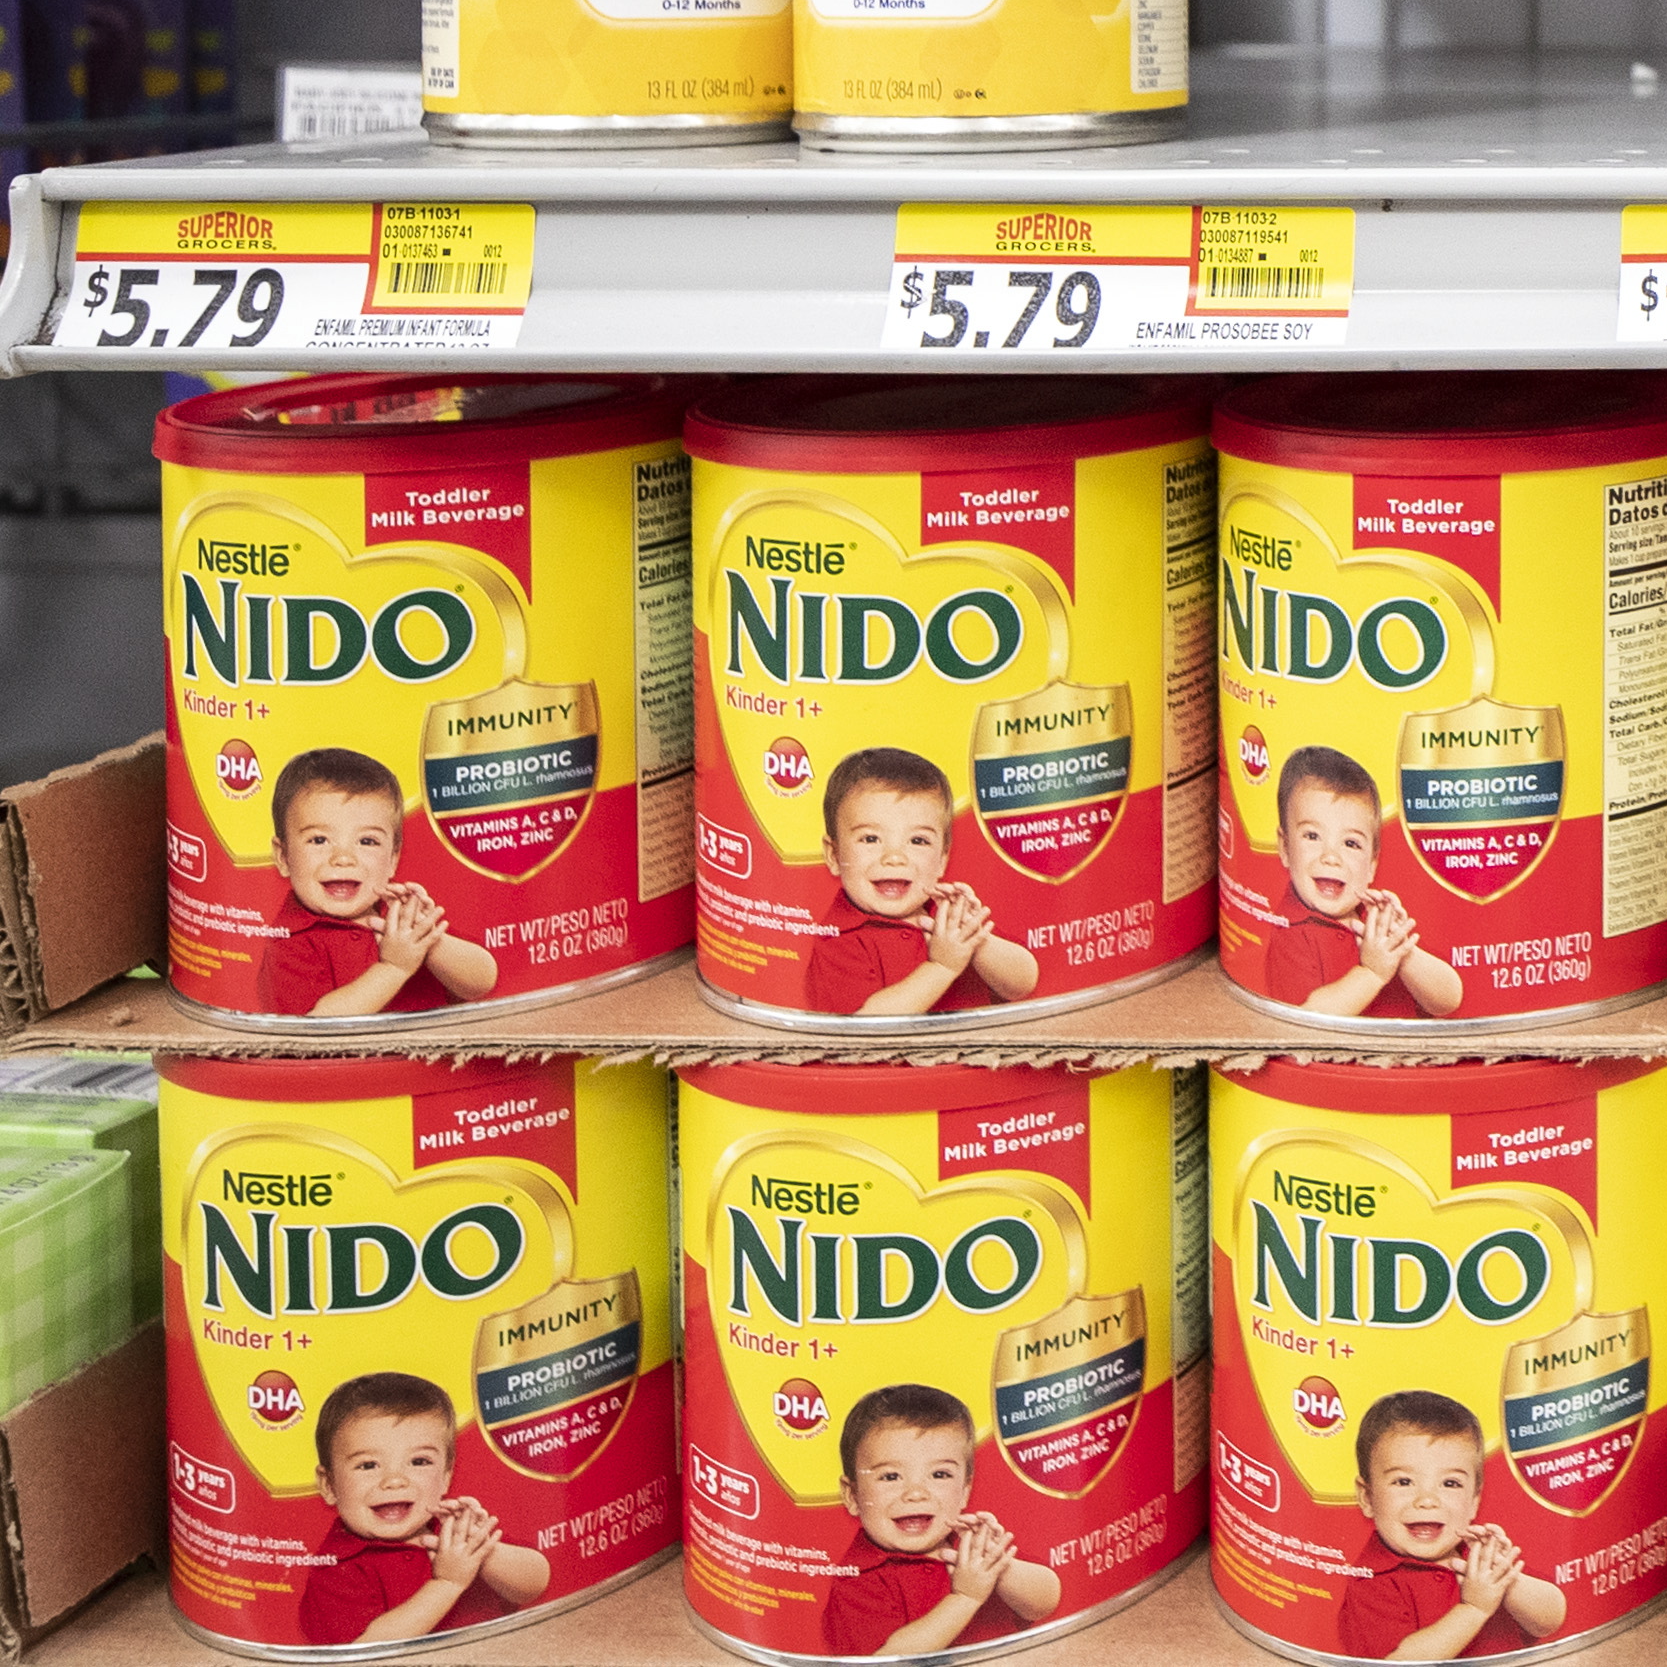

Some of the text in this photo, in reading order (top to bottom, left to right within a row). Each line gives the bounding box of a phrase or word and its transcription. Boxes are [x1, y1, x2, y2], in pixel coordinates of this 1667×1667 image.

[177, 211, 274, 239] SUPERIOR
[384, 225, 474, 239] 030087136741
[82, 266, 285, 348] $5.79
[900, 265, 1102, 348] $5.79
[314, 318, 491, 336] ENFAMIL PREMIUM INFANT FORMULA
[1136, 323, 1196, 340] ENFAMIL
[1201, 323, 1278, 340] PROSOBEE
[1282, 323, 1313, 340] SOY
[1358, 516, 1496, 535] Milk Beverage
[1387, 499, 1463, 515] Toddler
[197, 538, 290, 577] Nestlé
[1229, 526, 1293, 570] Nestlé
[182, 574, 475, 686] NIDO
[1223, 557, 1447, 692] NIDO
[1421, 727, 1539, 748] IMMUNITY
[1428, 776, 1537, 794] PROBIOTIC
[223, 1170, 332, 1207] Nestlé
[751, 1175, 860, 1215] Nestlé
[200, 1203, 524, 1318] NIDO
[726, 1206, 1040, 1326] NIDO
[729, 1324, 838, 1359] Kinder 1+
